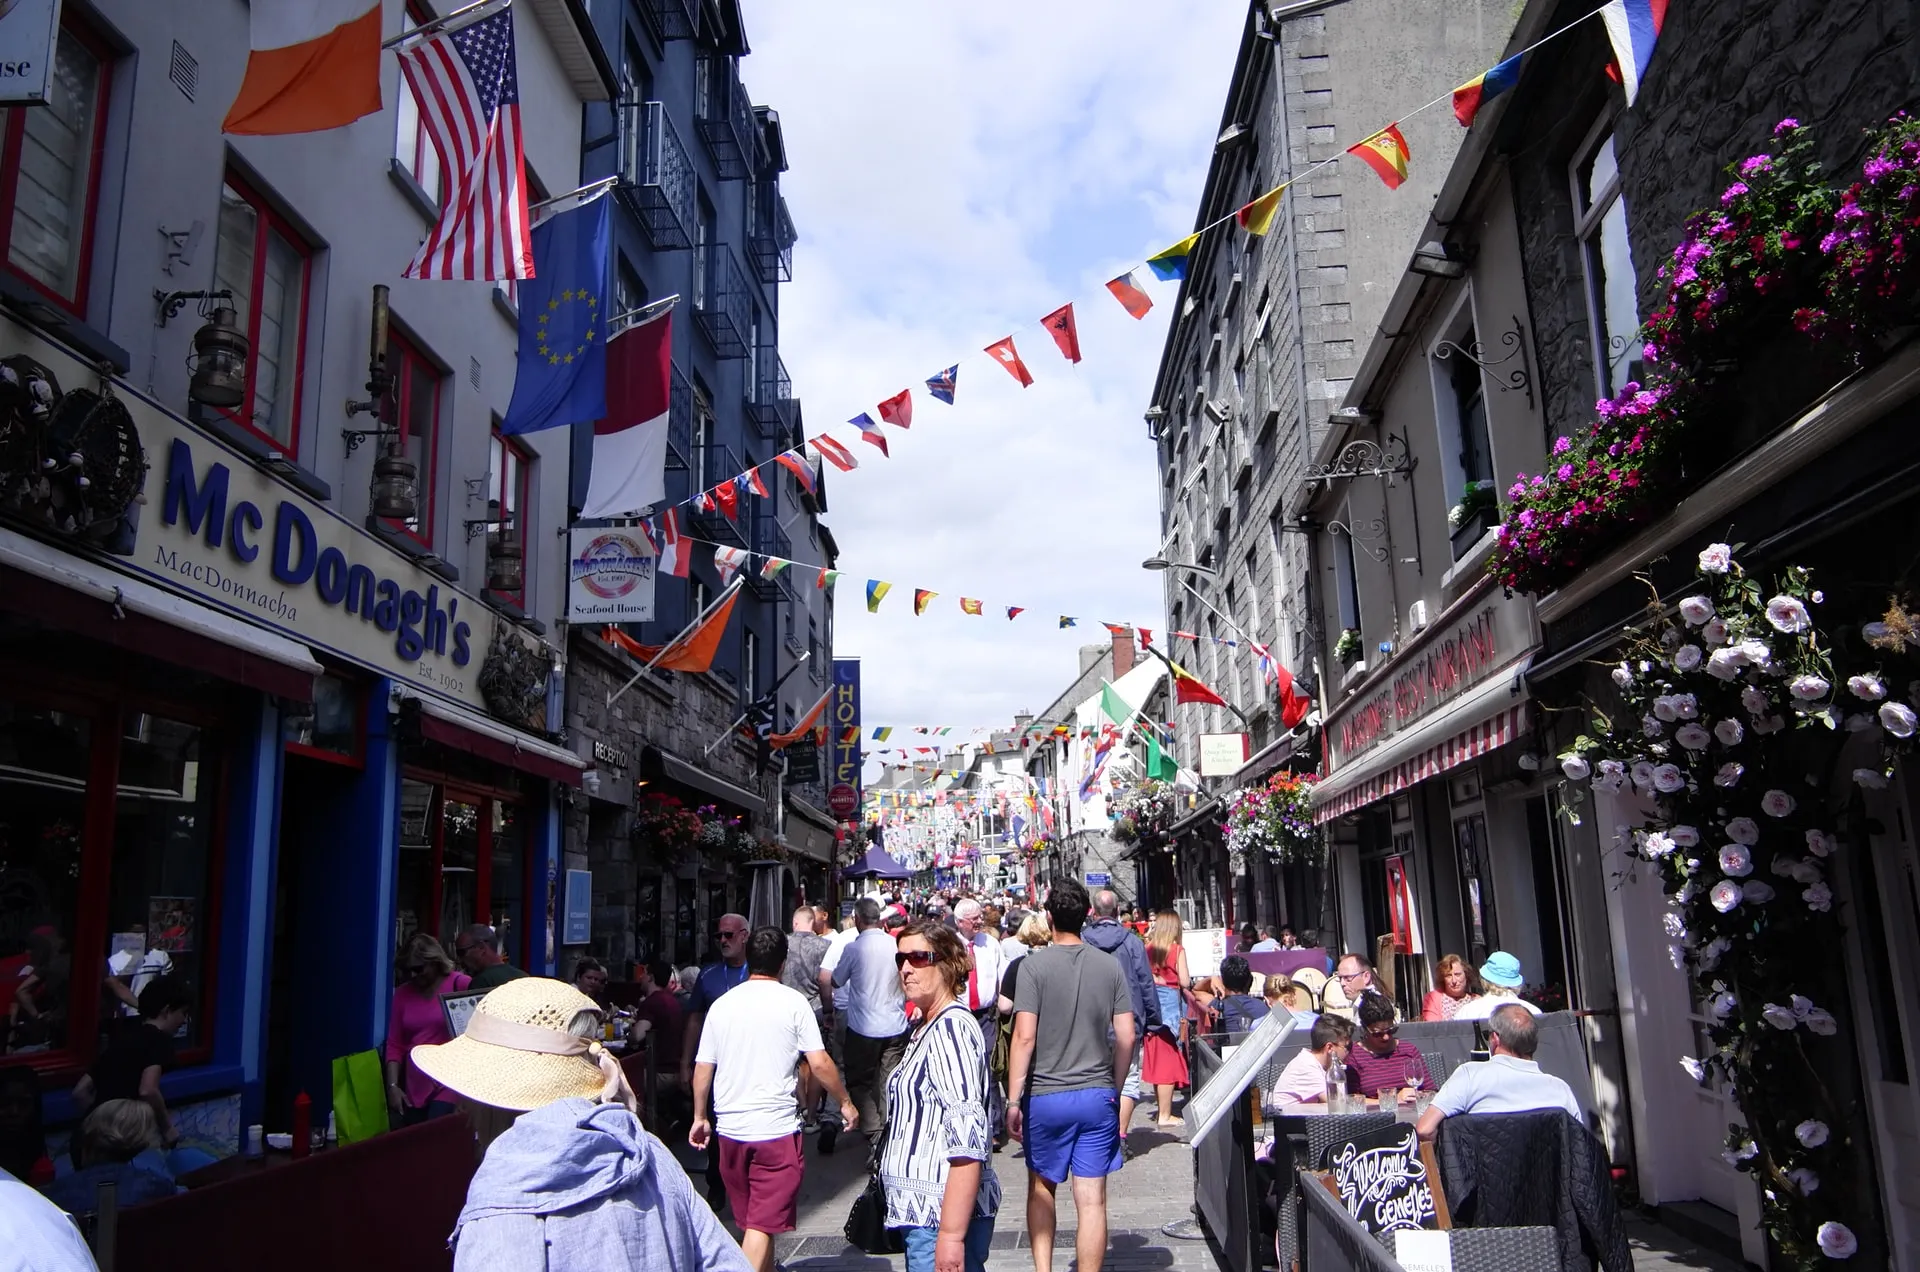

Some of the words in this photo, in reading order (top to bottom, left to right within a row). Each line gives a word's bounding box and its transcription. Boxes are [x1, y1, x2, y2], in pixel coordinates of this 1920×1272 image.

[154, 545, 297, 621] MacDonnacha
[575, 604, 615, 615] Seafood
[617, 604, 647, 614] House
[418, 661, 437, 682] Est.
[439, 672, 464, 694] 1902
[1352, 1149, 1409, 1195] Welcome
